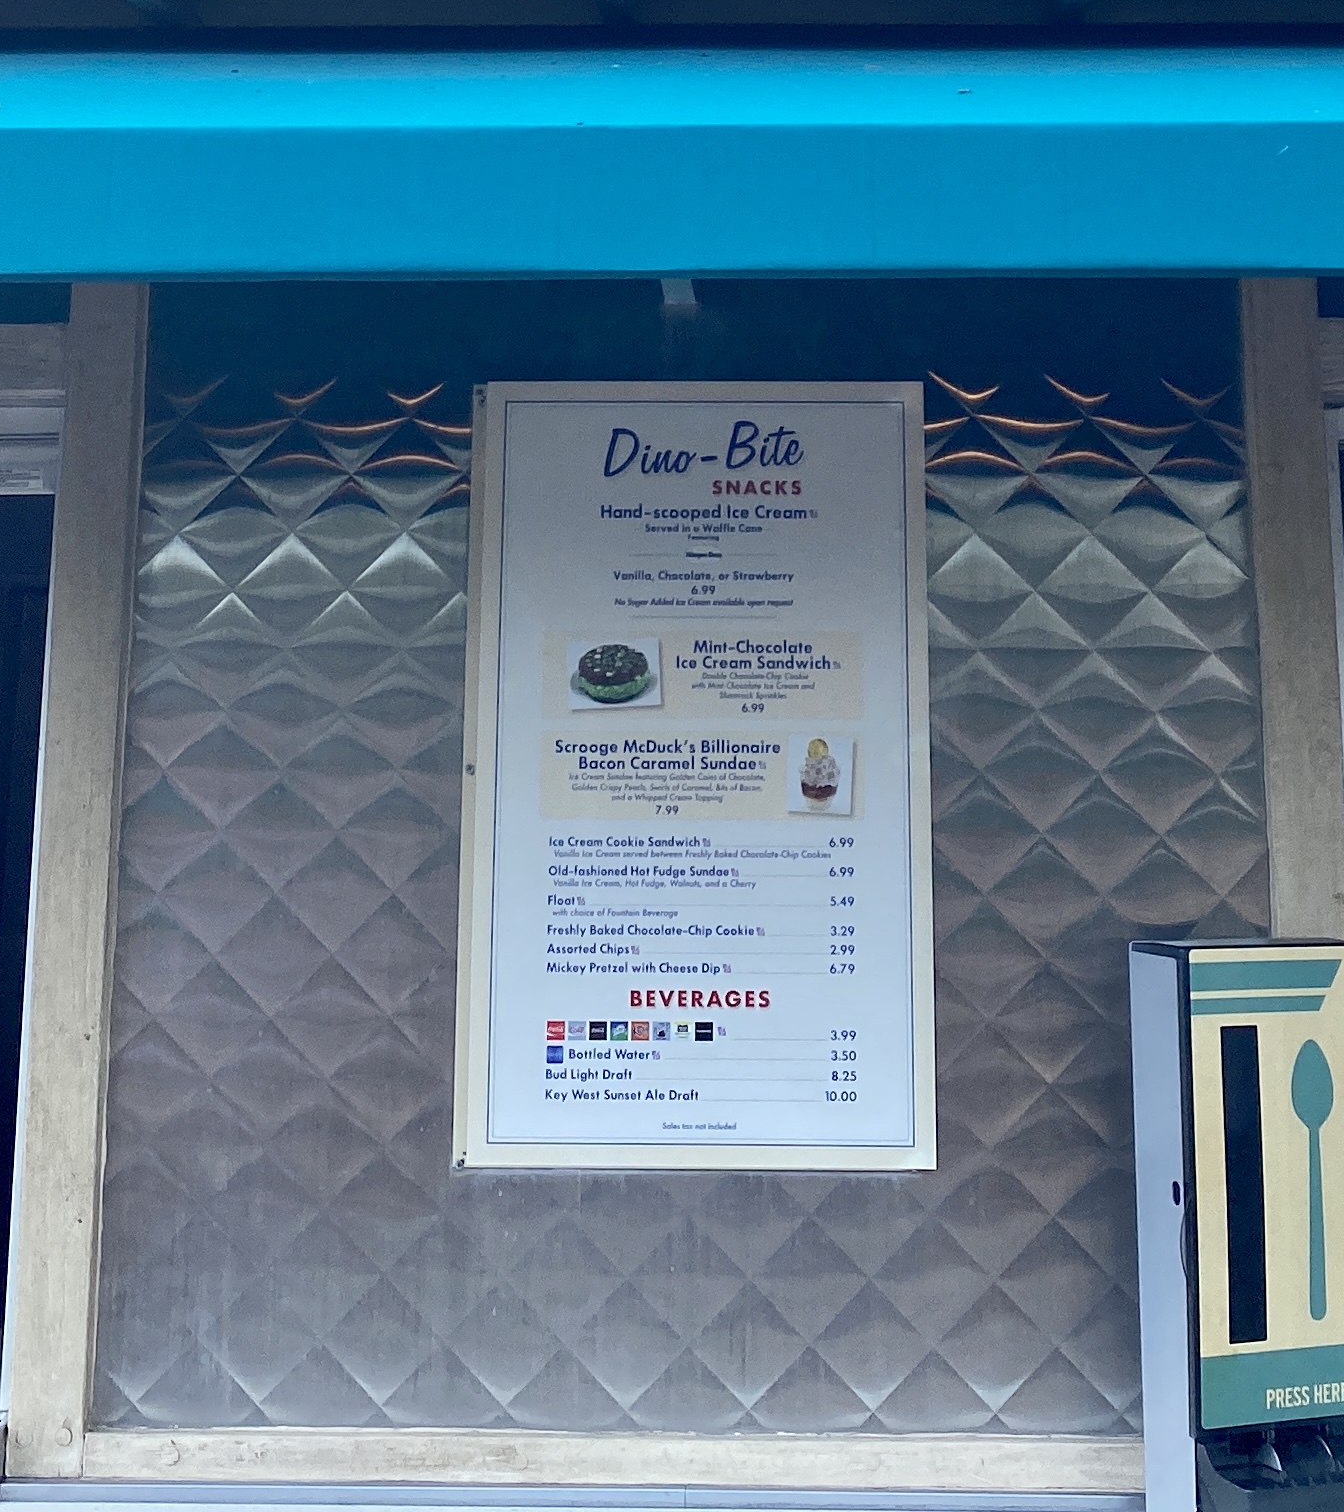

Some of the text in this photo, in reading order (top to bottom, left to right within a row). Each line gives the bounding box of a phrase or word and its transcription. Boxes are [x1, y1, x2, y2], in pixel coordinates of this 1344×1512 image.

[603, 420, 804, 477] Dino-Bite
[712, 480, 802, 495] SNACKS
[600, 504, 807, 521] Hand-scooped Ice Cream
[645, 523, 679, 533] Served
[682, 523, 691, 533] in
[702, 523, 735, 533] Waffle
[613, 570, 654, 582] Vanilla,
[718, 572, 729, 581] or
[733, 570, 794, 583] Strawberry
[691, 585, 716, 595] 6.99
[693, 639, 813, 654] Mint-Chocolate
[676, 655, 831, 669] Ice Cream Sandwich
[741, 703, 765, 713] 6.99
[555, 739, 781, 756] Scrooge McDuck's Billionaire
[579, 756, 757, 770] Bacon Caramel Sundae
[655, 805, 679, 815] 7.99
[549, 836, 854, 848] Ice Cream Cookie Sandwich 6.99
[582, 849, 593, 858] Ice
[623, 849, 648, 858] served
[548, 865, 854, 879] Old-fashioned Hot Fudge Sundae 6.99
[581, 878, 592, 887] Ice
[730, 879, 756, 890] Cherry
[547, 894, 855, 907] Float 5.49
[570, 908, 594, 917] choice
[597, 908, 605, 917] of
[547, 924, 855, 938] Freshly Baked Chocolate-Chip Cookie 3.29
[547, 943, 855, 956] Assorted Chips 2.99
[546, 961, 855, 975] Mickey Pretzel with Cheese Dip 6.79
[630, 990, 771, 1008] BEVERAGES
[830, 1030, 857, 1041] 3.99
[568, 1048, 857, 1061] Bottled Water 3.50
[545, 1068, 857, 1082] Bud Light Draft 8.25
[545, 1089, 857, 1102] Key West Sunset Ale Draft 10.00
[1266, 1386, 1310, 1410] PRESS
